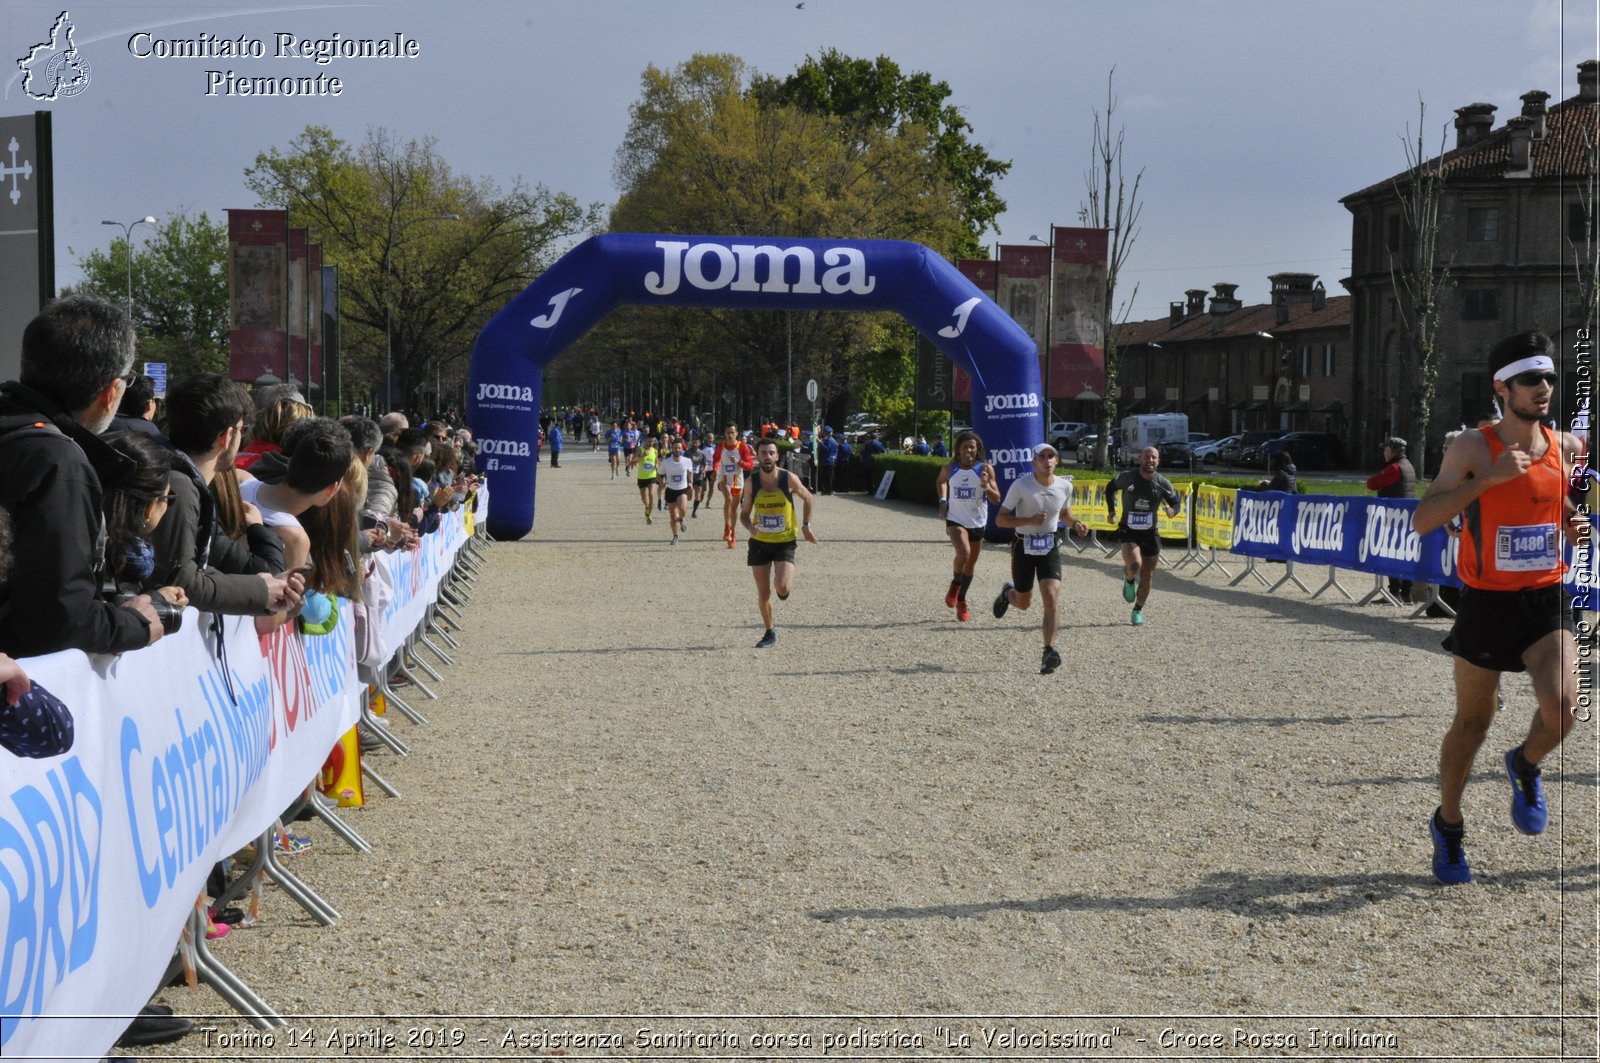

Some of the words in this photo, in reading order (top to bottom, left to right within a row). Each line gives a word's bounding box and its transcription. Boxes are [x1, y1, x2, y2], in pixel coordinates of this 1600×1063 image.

[644, 240, 875, 295] Joma
[477, 384, 533, 402] Joma
[985, 393, 1039, 412] Joma
[475, 439, 531, 456] Joma
[989, 448, 1033, 466] Jom
[1292, 502, 1345, 556] Joma
[1512, 535, 1545, 553] 1480
[120, 675, 228, 909] Central
